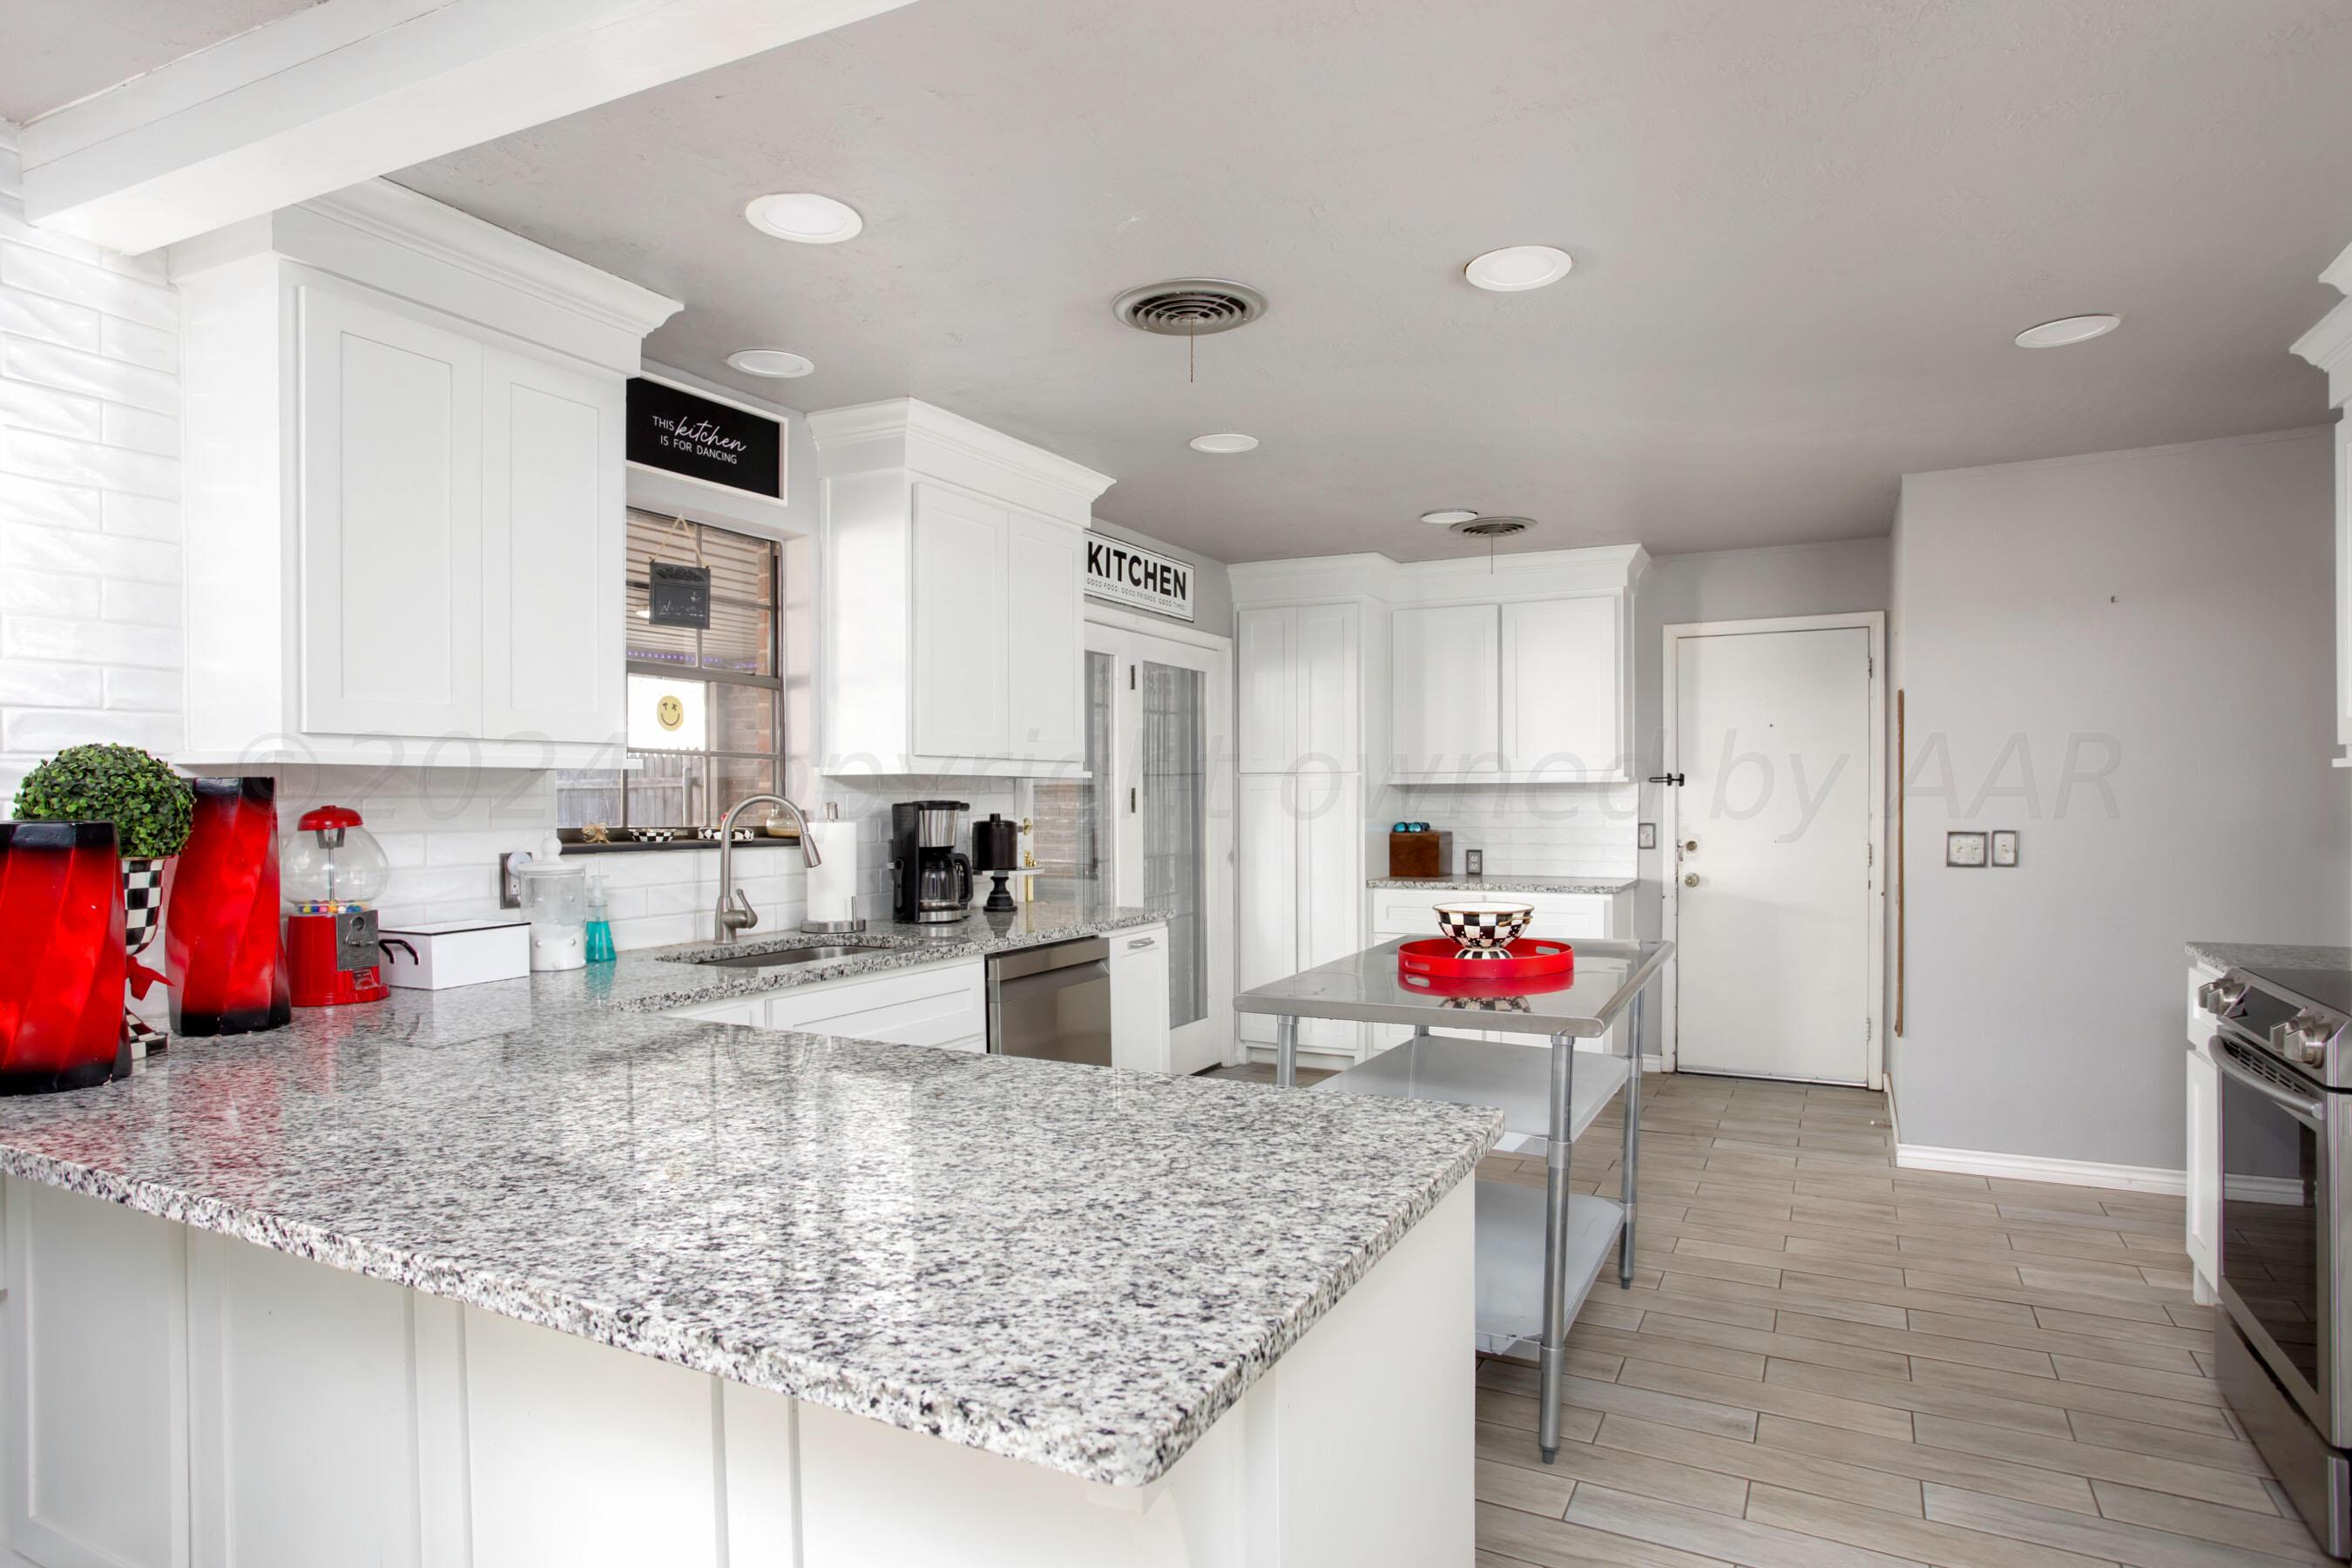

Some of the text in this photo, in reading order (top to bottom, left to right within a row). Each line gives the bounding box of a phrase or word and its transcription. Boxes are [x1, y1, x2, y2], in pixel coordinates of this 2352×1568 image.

[652, 415, 747, 452] THIS kitchen
[660, 435, 738, 464] IS FOR DANCING
[1087, 540, 1186, 601] KITCHEN
